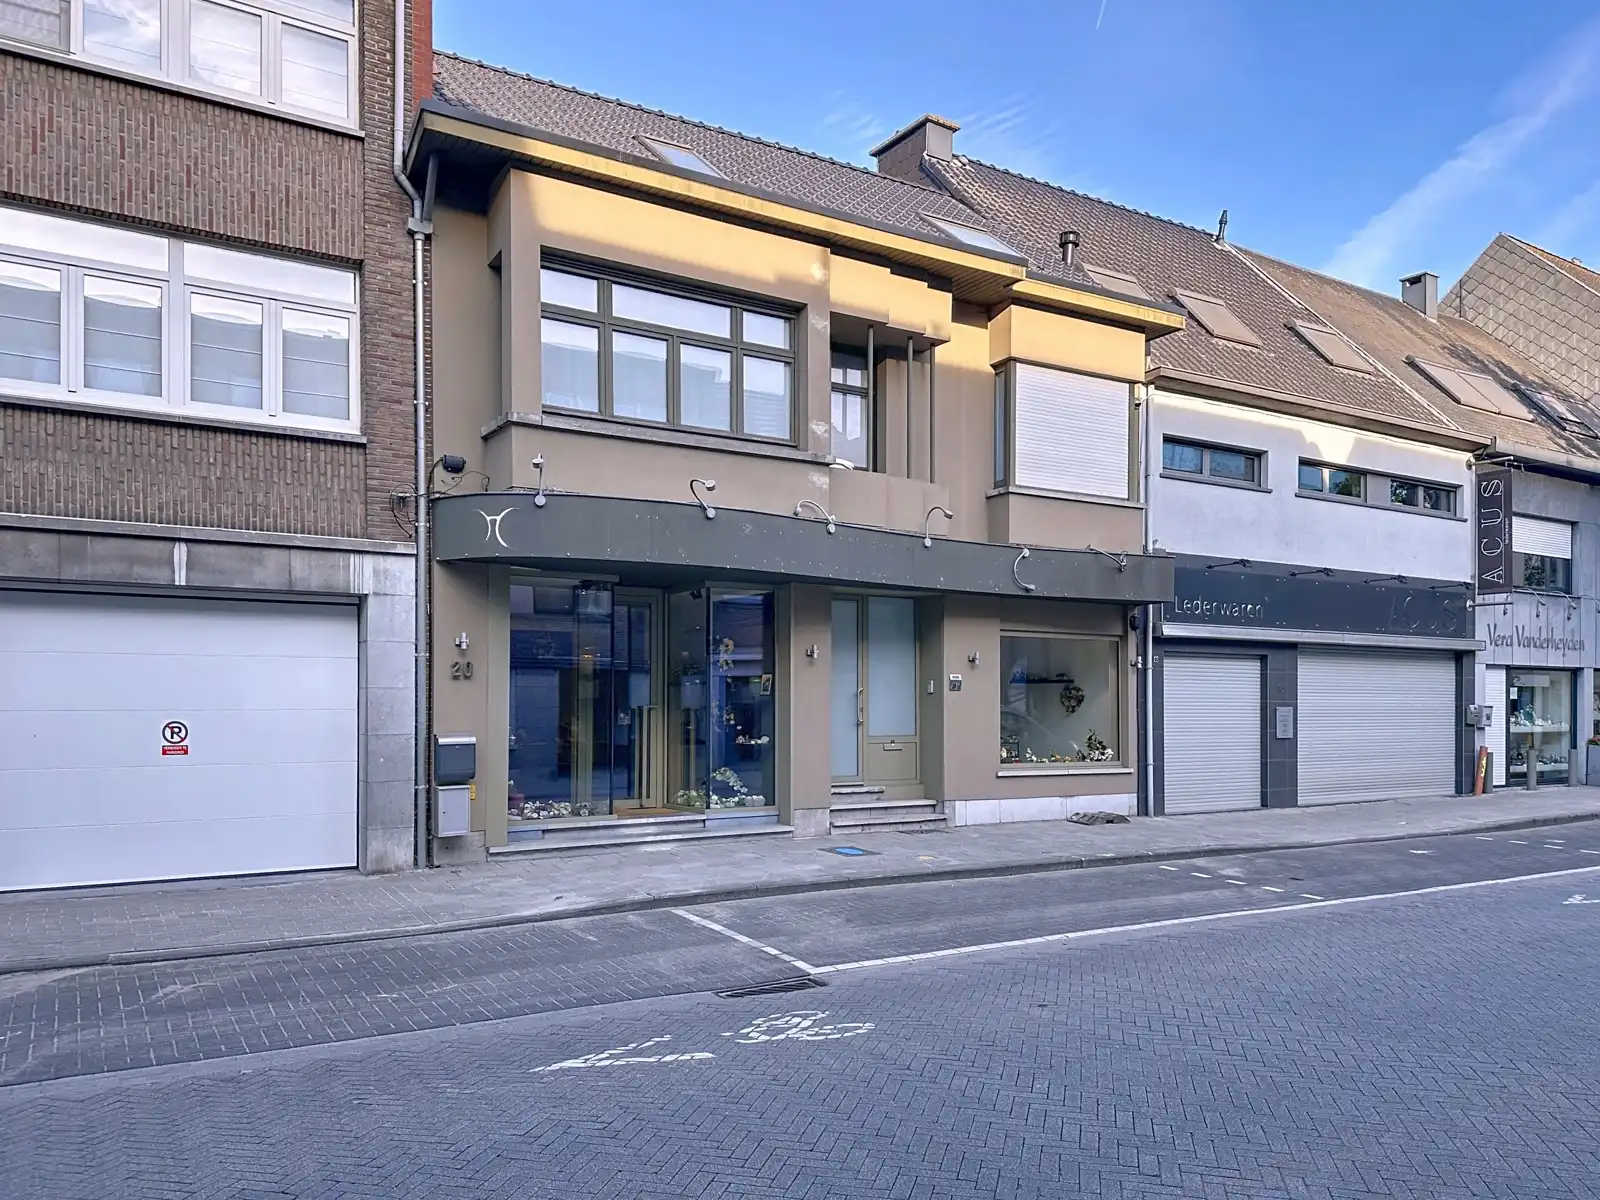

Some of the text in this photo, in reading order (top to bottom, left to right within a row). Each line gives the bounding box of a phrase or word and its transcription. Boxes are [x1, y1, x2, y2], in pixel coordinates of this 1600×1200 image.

[1480, 479, 1503, 584] ACUS
[1174, 595, 1264, 619] Lederwaren
[1486, 623, 1585, 657] Vera Vanderheyden
[450, 660, 473, 680] 20
